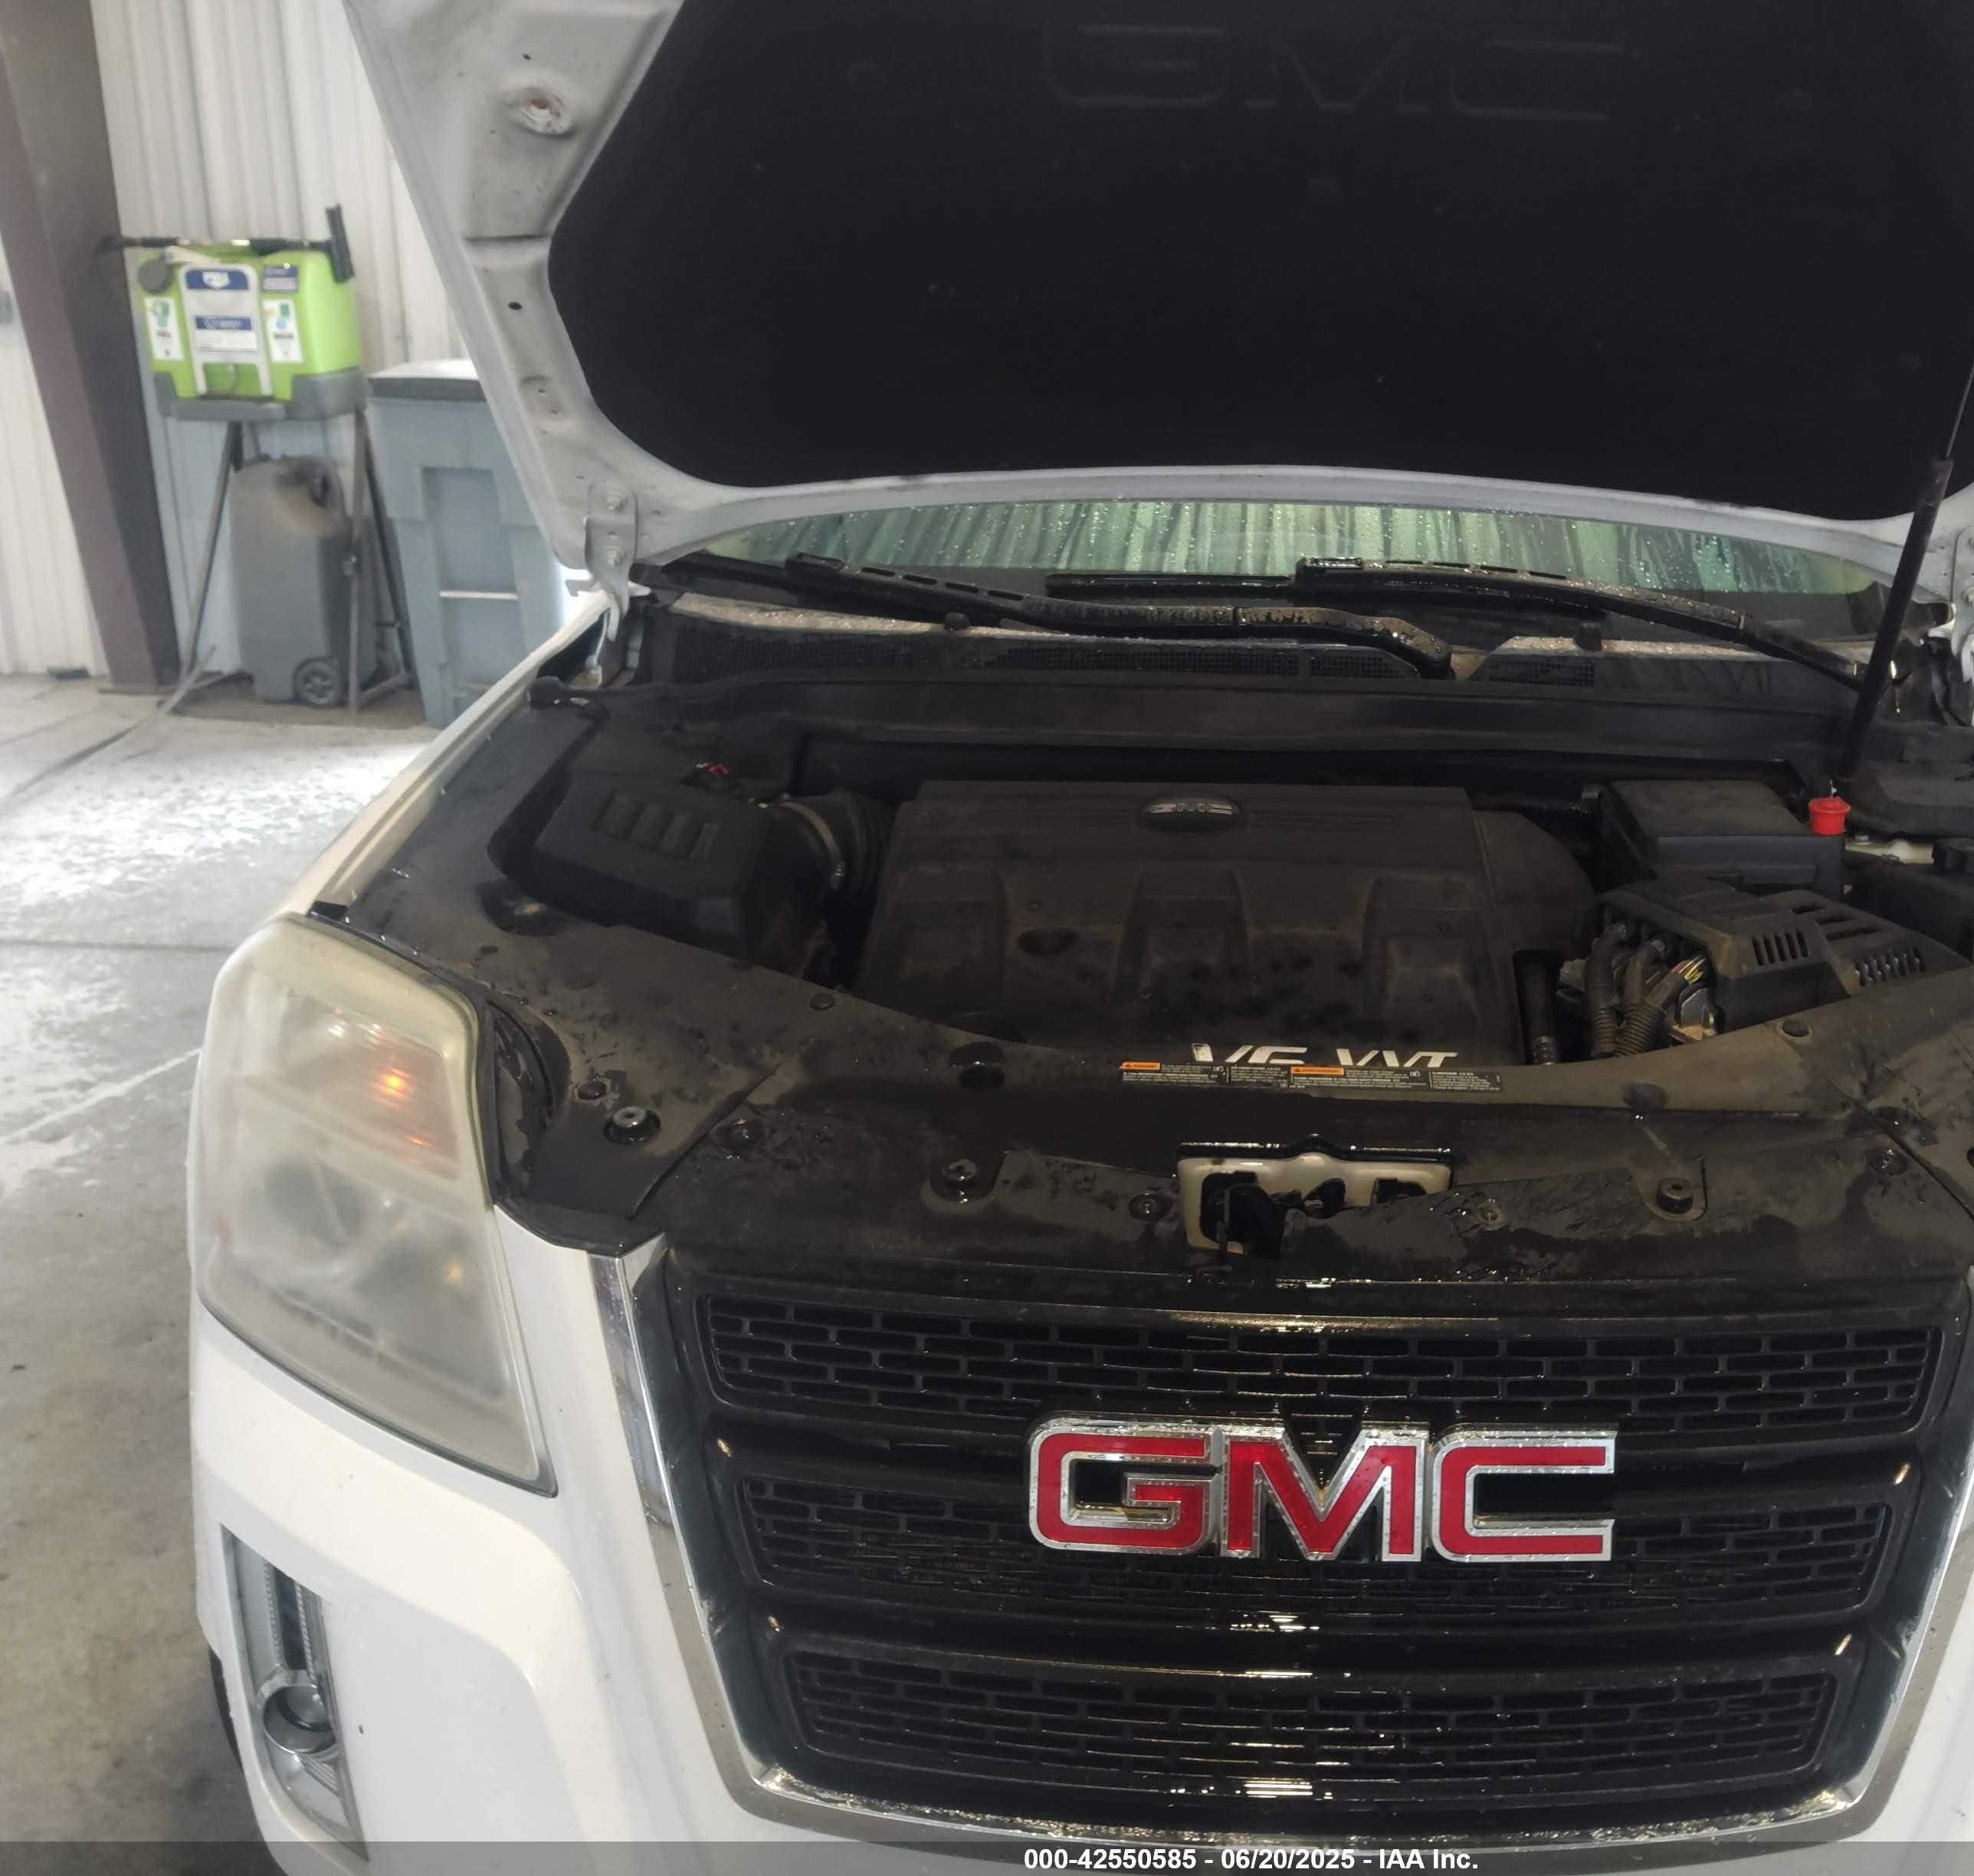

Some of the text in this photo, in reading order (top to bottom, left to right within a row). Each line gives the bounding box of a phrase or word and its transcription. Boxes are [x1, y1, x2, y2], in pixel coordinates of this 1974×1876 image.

[1150, 802, 1233, 815] GMC
[1336, 1048, 1458, 1068] VVT
[1028, 1411, 1618, 1563] GMC
